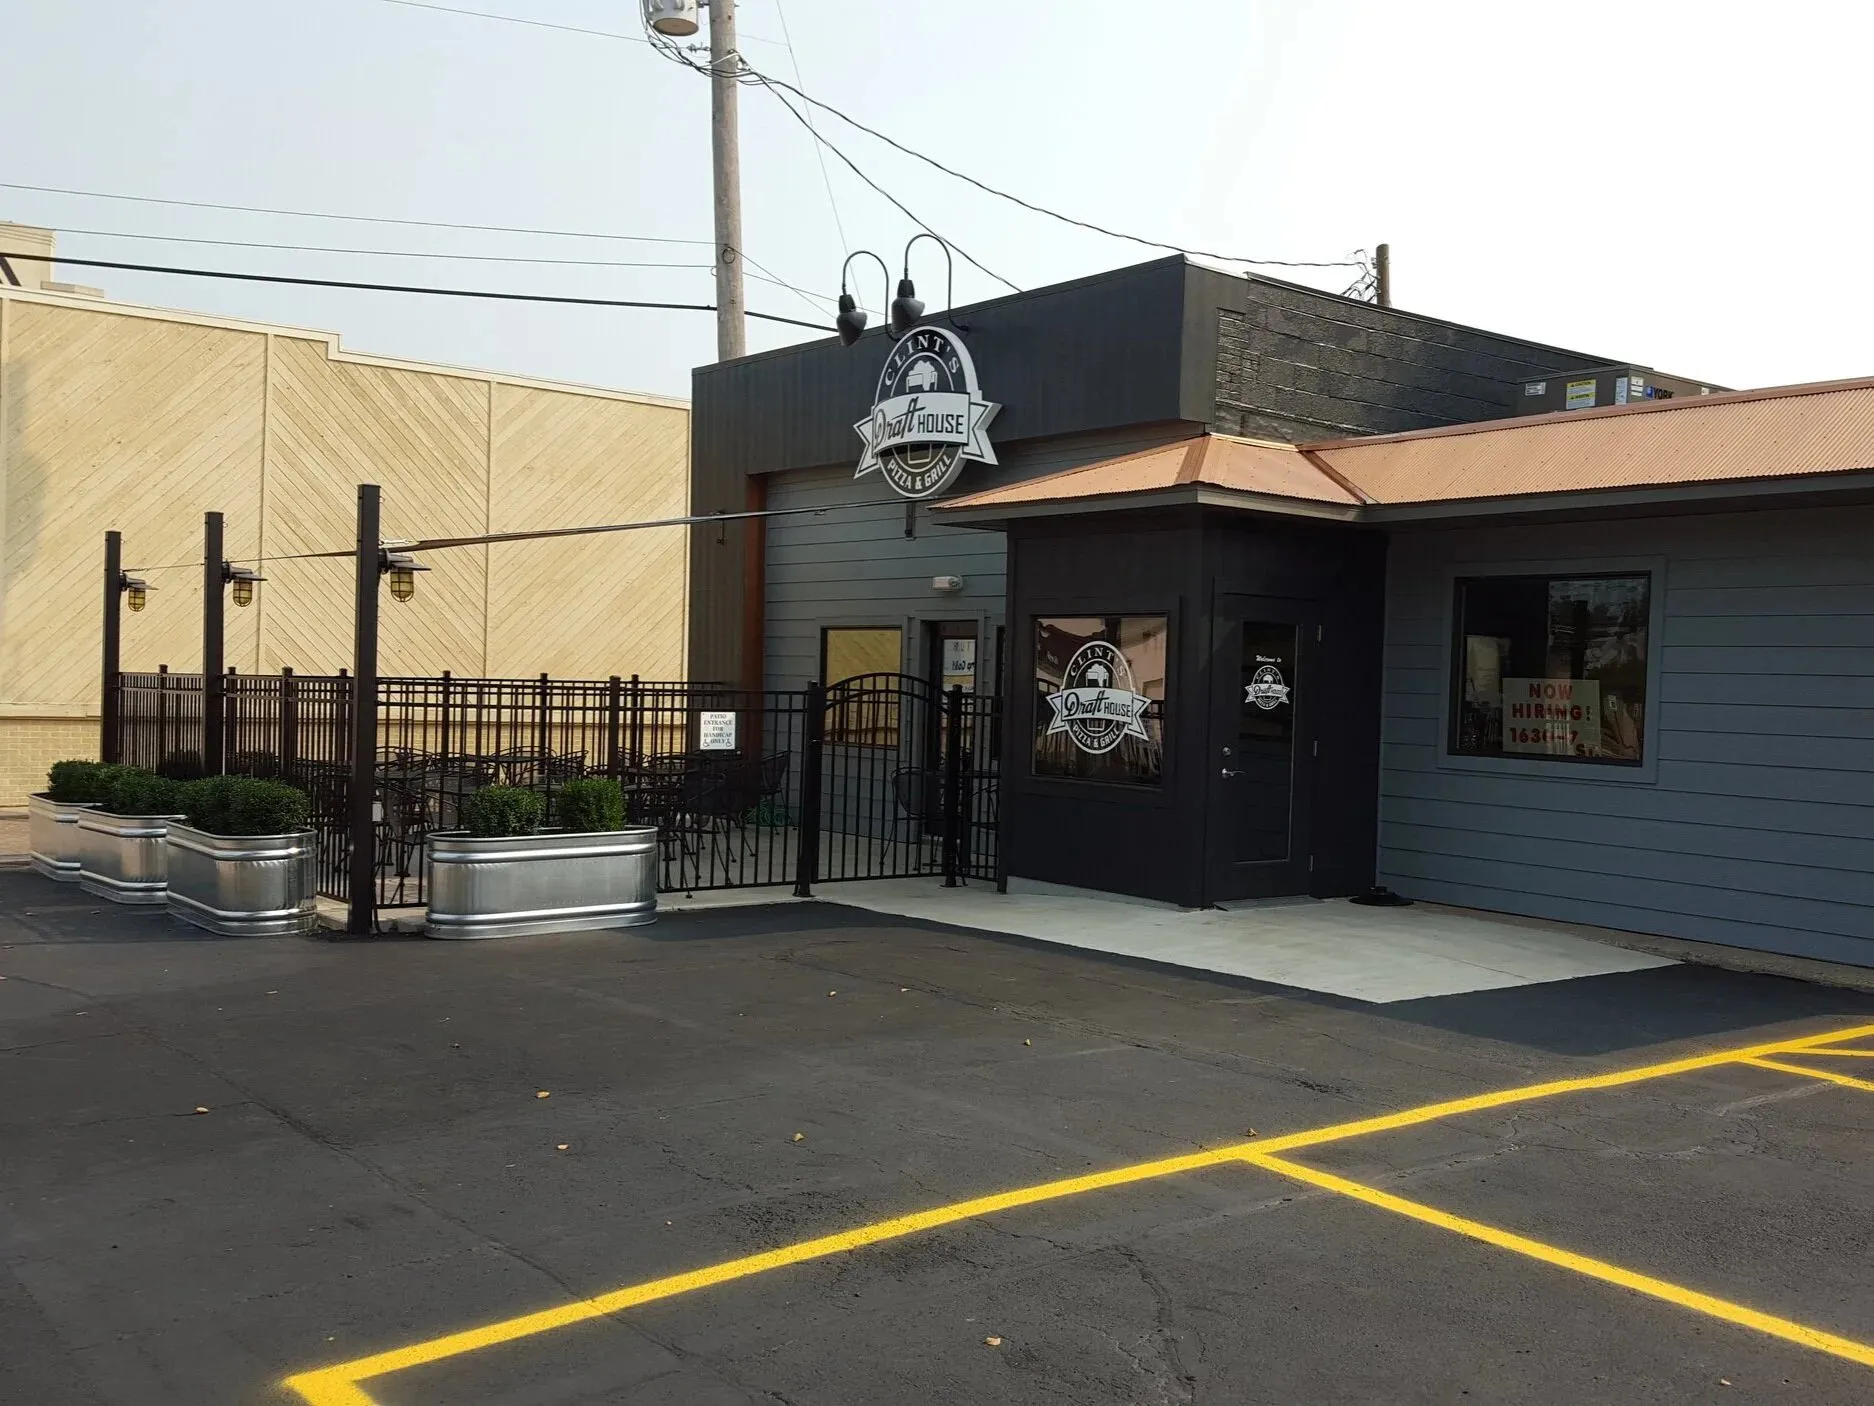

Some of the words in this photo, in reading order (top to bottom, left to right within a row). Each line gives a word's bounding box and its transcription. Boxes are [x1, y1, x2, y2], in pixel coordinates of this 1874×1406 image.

[884, 334, 960, 387] CLINT'S
[874, 396, 926, 448] Draft
[917, 413, 964, 435] HOUSE
[887, 458, 912, 490] PIZZA
[915, 475, 922, 490] &
[924, 454, 952, 486] GRILL
[1070, 647, 1127, 677] CLINT'S
[1064, 690, 1111, 717] Draft
[1103, 701, 1131, 718] HOUSE
[1529, 683, 1573, 700] NOW
[1073, 724, 1091, 748] PIZZA
[1093, 737, 1099, 748] &
[1099, 728, 1120, 748] GRILL
